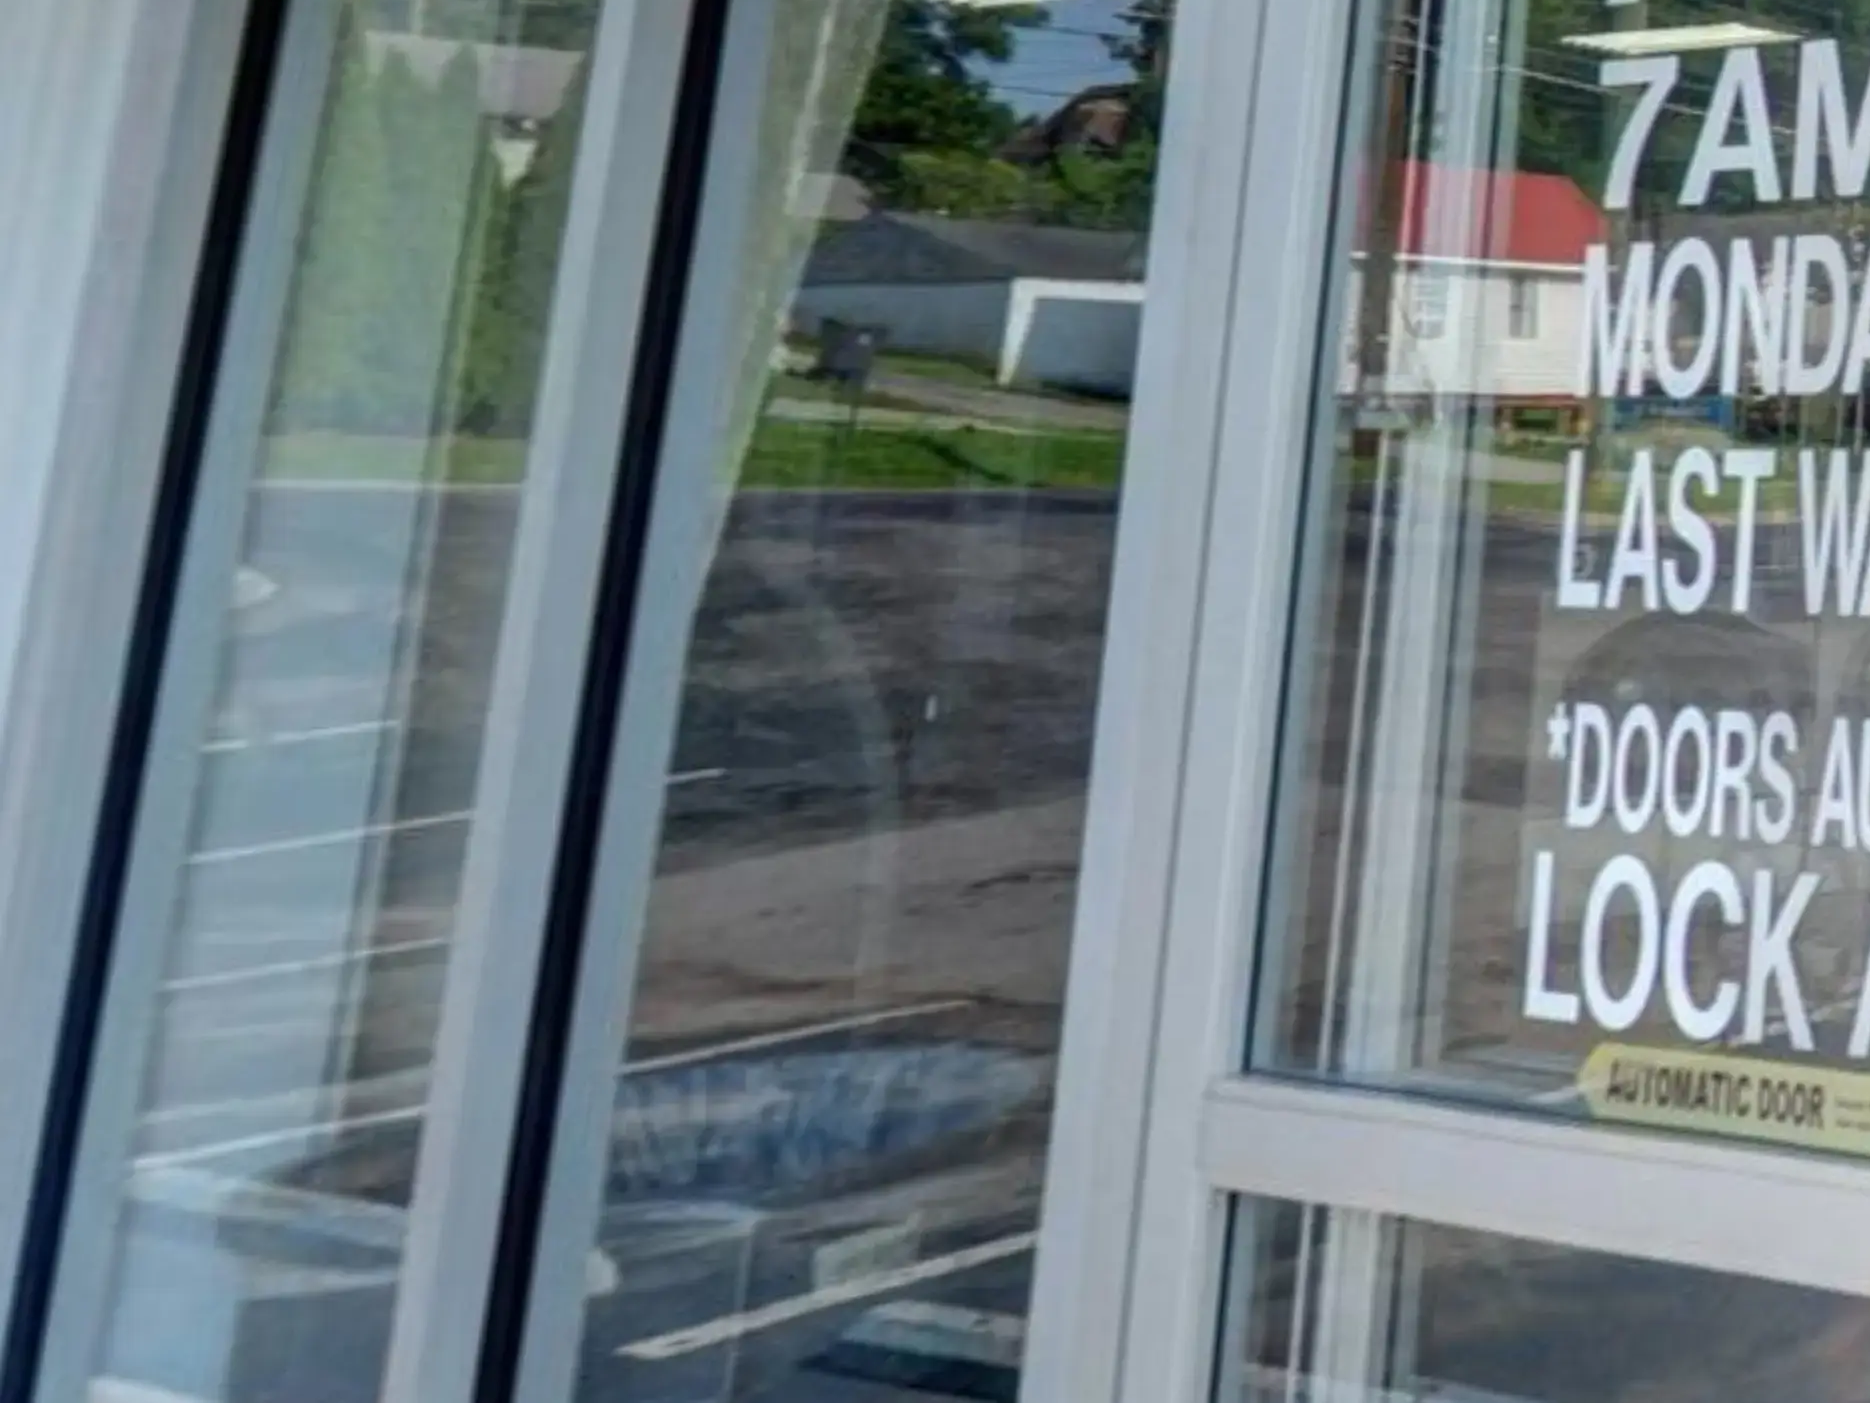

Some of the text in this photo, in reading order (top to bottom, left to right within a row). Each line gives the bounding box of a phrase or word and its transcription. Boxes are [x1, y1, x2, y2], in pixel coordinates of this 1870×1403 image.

[1556, 449, 1774, 616] LAST
[1521, 853, 1818, 1053] LOCK
[1604, 1059, 1750, 1119] AUTOMATIC
[1757, 1076, 1826, 1128] DOOR
